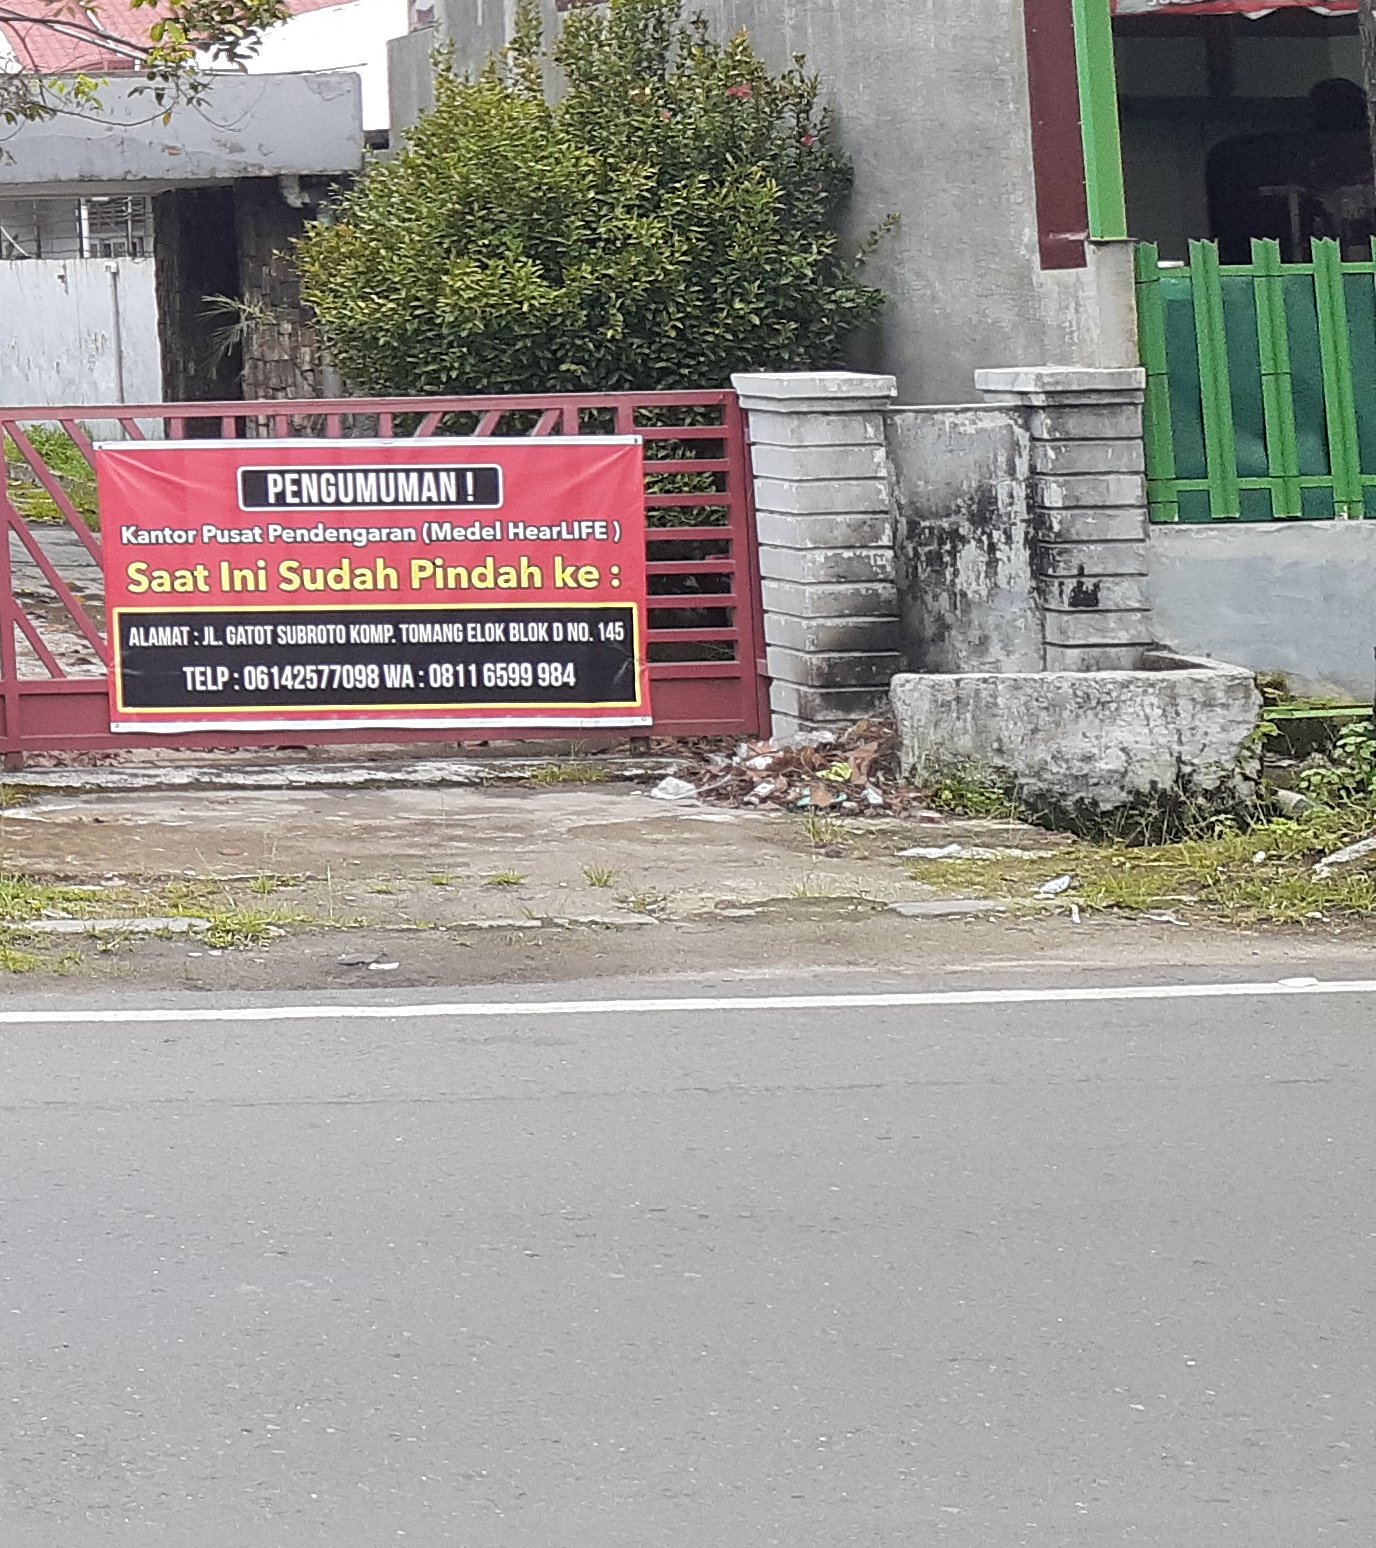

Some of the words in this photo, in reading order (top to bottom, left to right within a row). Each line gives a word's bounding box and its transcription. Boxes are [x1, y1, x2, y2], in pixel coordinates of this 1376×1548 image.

[267, 471, 457, 504] PENGUMUMAN
[466, 471, 475, 502] !
[121, 525, 196, 544] Kantor
[202, 524, 263, 543] Pusat
[268, 522, 416, 547] Pendengaran
[422, 520, 502, 544] (Medel
[508, 521, 608, 540] HearLIFE
[127, 561, 210, 593] Saat
[220, 559, 267, 592] Ini
[278, 557, 398, 591] Sudah
[410, 556, 542, 589] Pindah
[554, 555, 599, 588] ke
[610, 565, 621, 588] :
[128, 626, 190, 647] ALAMAT
[202, 626, 224, 646] JL.
[226, 625, 274, 646] GATOT
[277, 624, 346, 645] SUBROTO
[350, 623, 396, 645] KOMP.
[399, 623, 463, 644] TOMANG
[467, 622, 504, 643] ELOK
[509, 622, 549, 642] BLOK
[553, 622, 564, 642] D
[567, 622, 594, 642] NO.
[598, 621, 624, 641] 145
[182, 666, 229, 691] TELP
[243, 664, 380, 690] 06142577098
[384, 664, 415, 688] WA
[429, 663, 477, 688] 0811
[483, 662, 533, 688] 6599
[538, 662, 576, 687] 984
